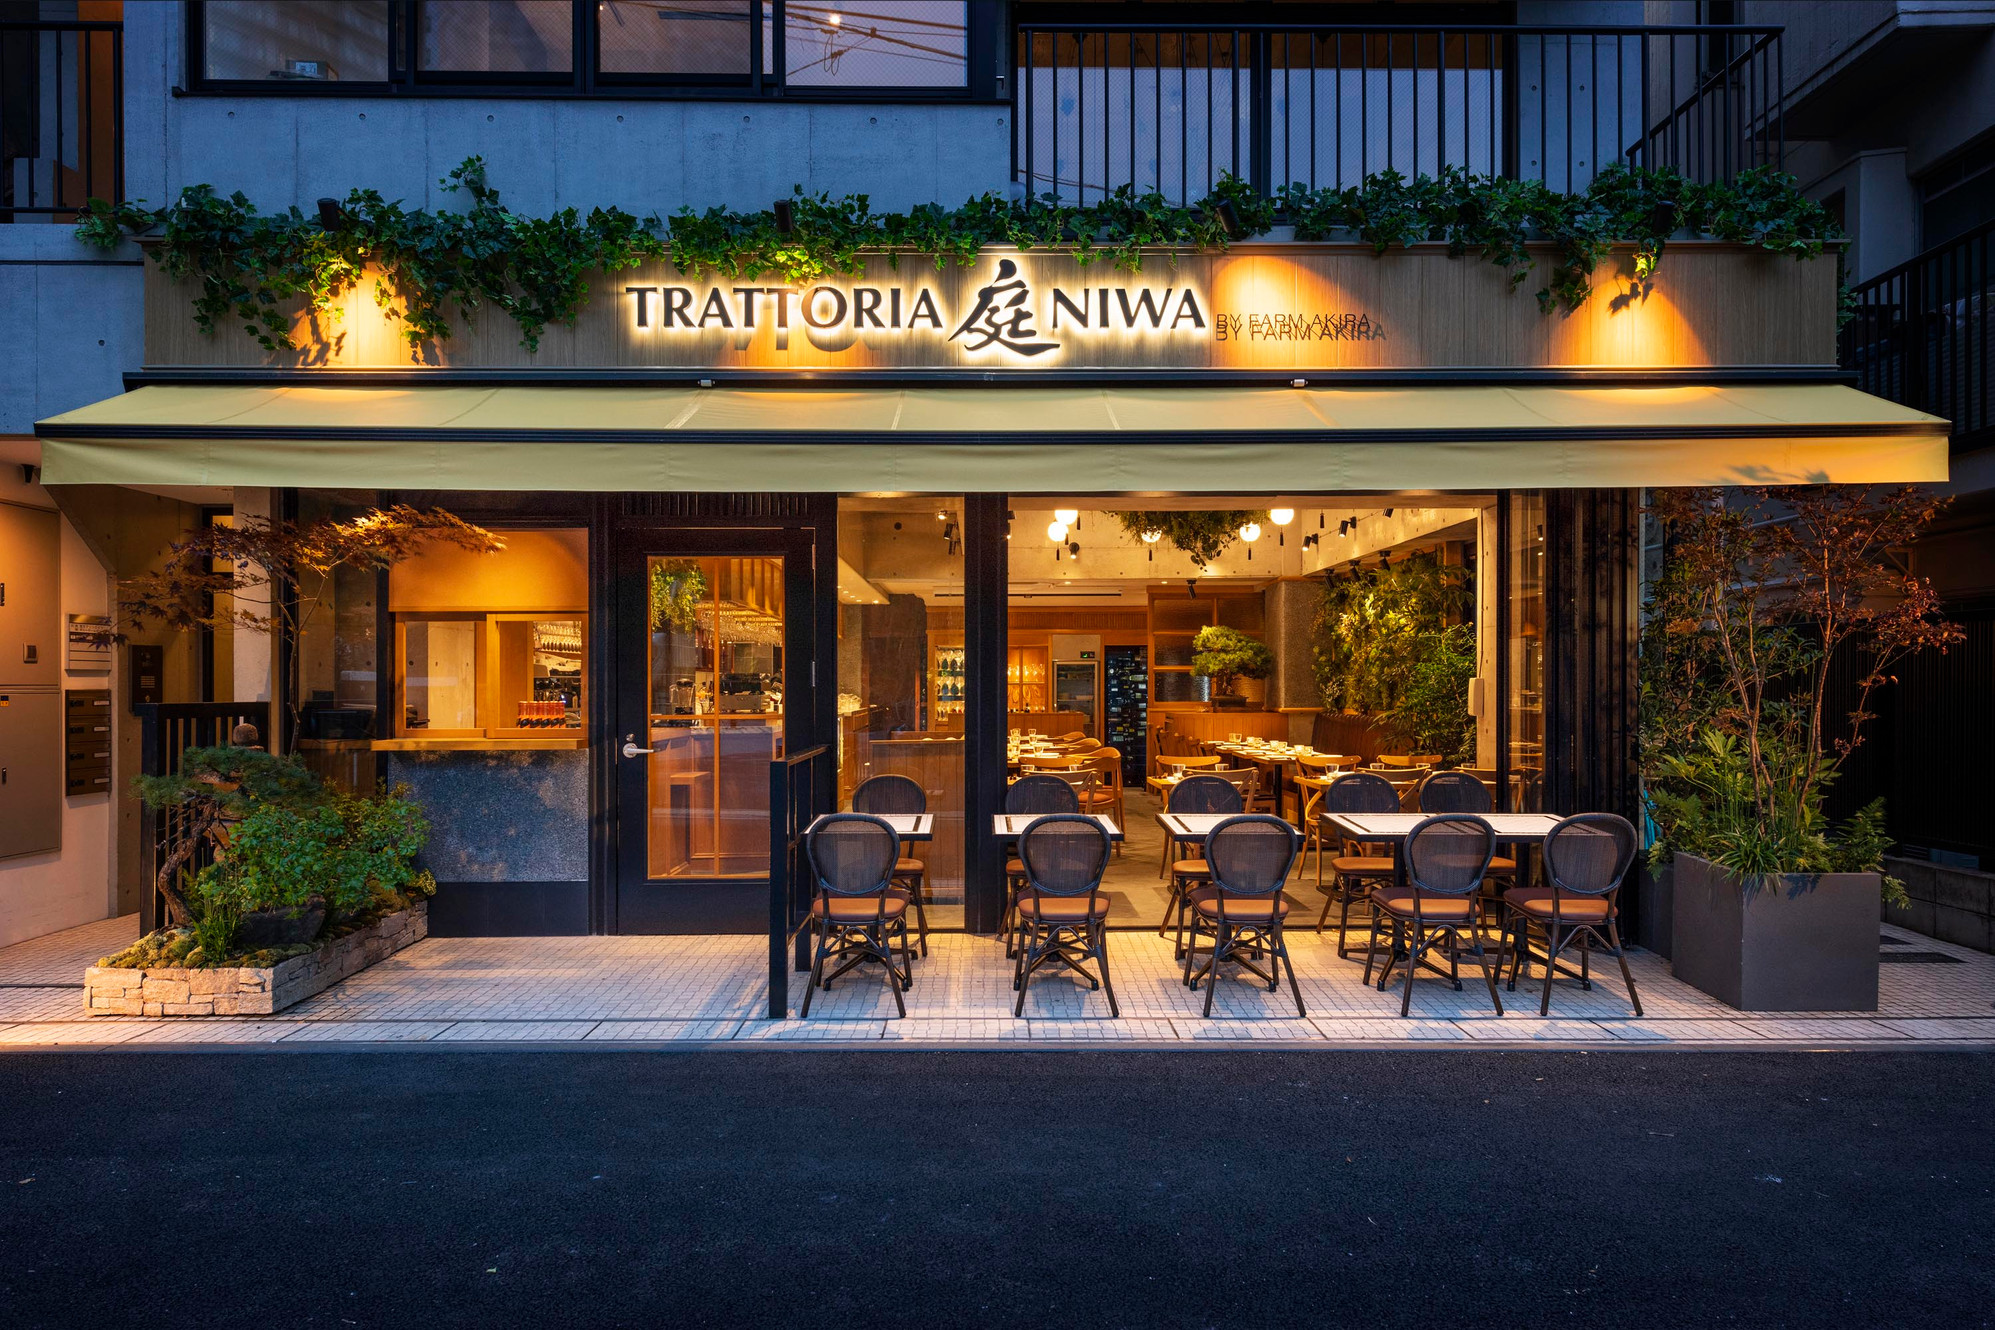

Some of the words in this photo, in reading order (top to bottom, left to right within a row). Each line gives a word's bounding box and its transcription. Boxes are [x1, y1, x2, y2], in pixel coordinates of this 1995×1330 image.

[625, 286, 943, 329] TRATTORIA
[948, 258, 1062, 357] 庭
[1052, 287, 1207, 329] NIWA
[1215, 313, 1243, 330] BY
[1248, 313, 1305, 330] FARM
[1310, 313, 1372, 330] AKIRA
